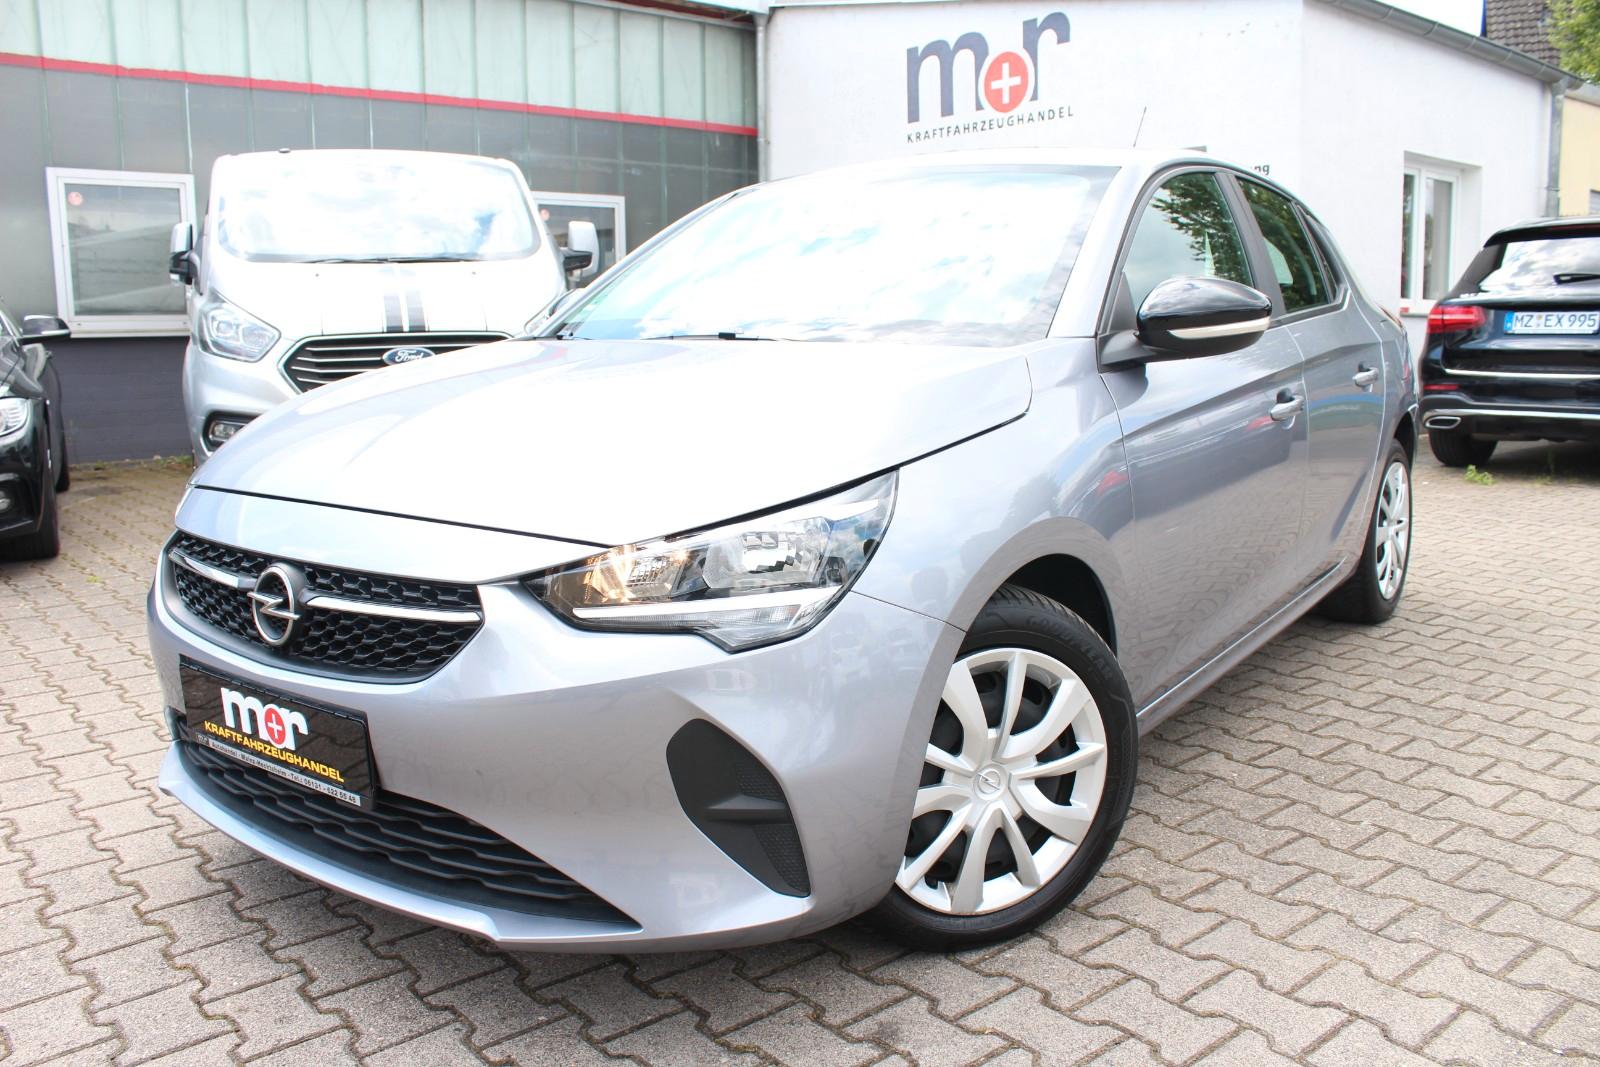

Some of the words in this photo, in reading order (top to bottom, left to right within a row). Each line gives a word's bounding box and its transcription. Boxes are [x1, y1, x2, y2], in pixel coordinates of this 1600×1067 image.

[906, 105, 1074, 144] KRAFTFAHRZEUGHANDEL
[1514, 314, 1533, 328] MZ
[1544, 313, 1565, 328] EX
[1568, 313, 1598, 328] 995
[204, 720, 345, 783] KRAFTFAHRZEUGHANDEL
